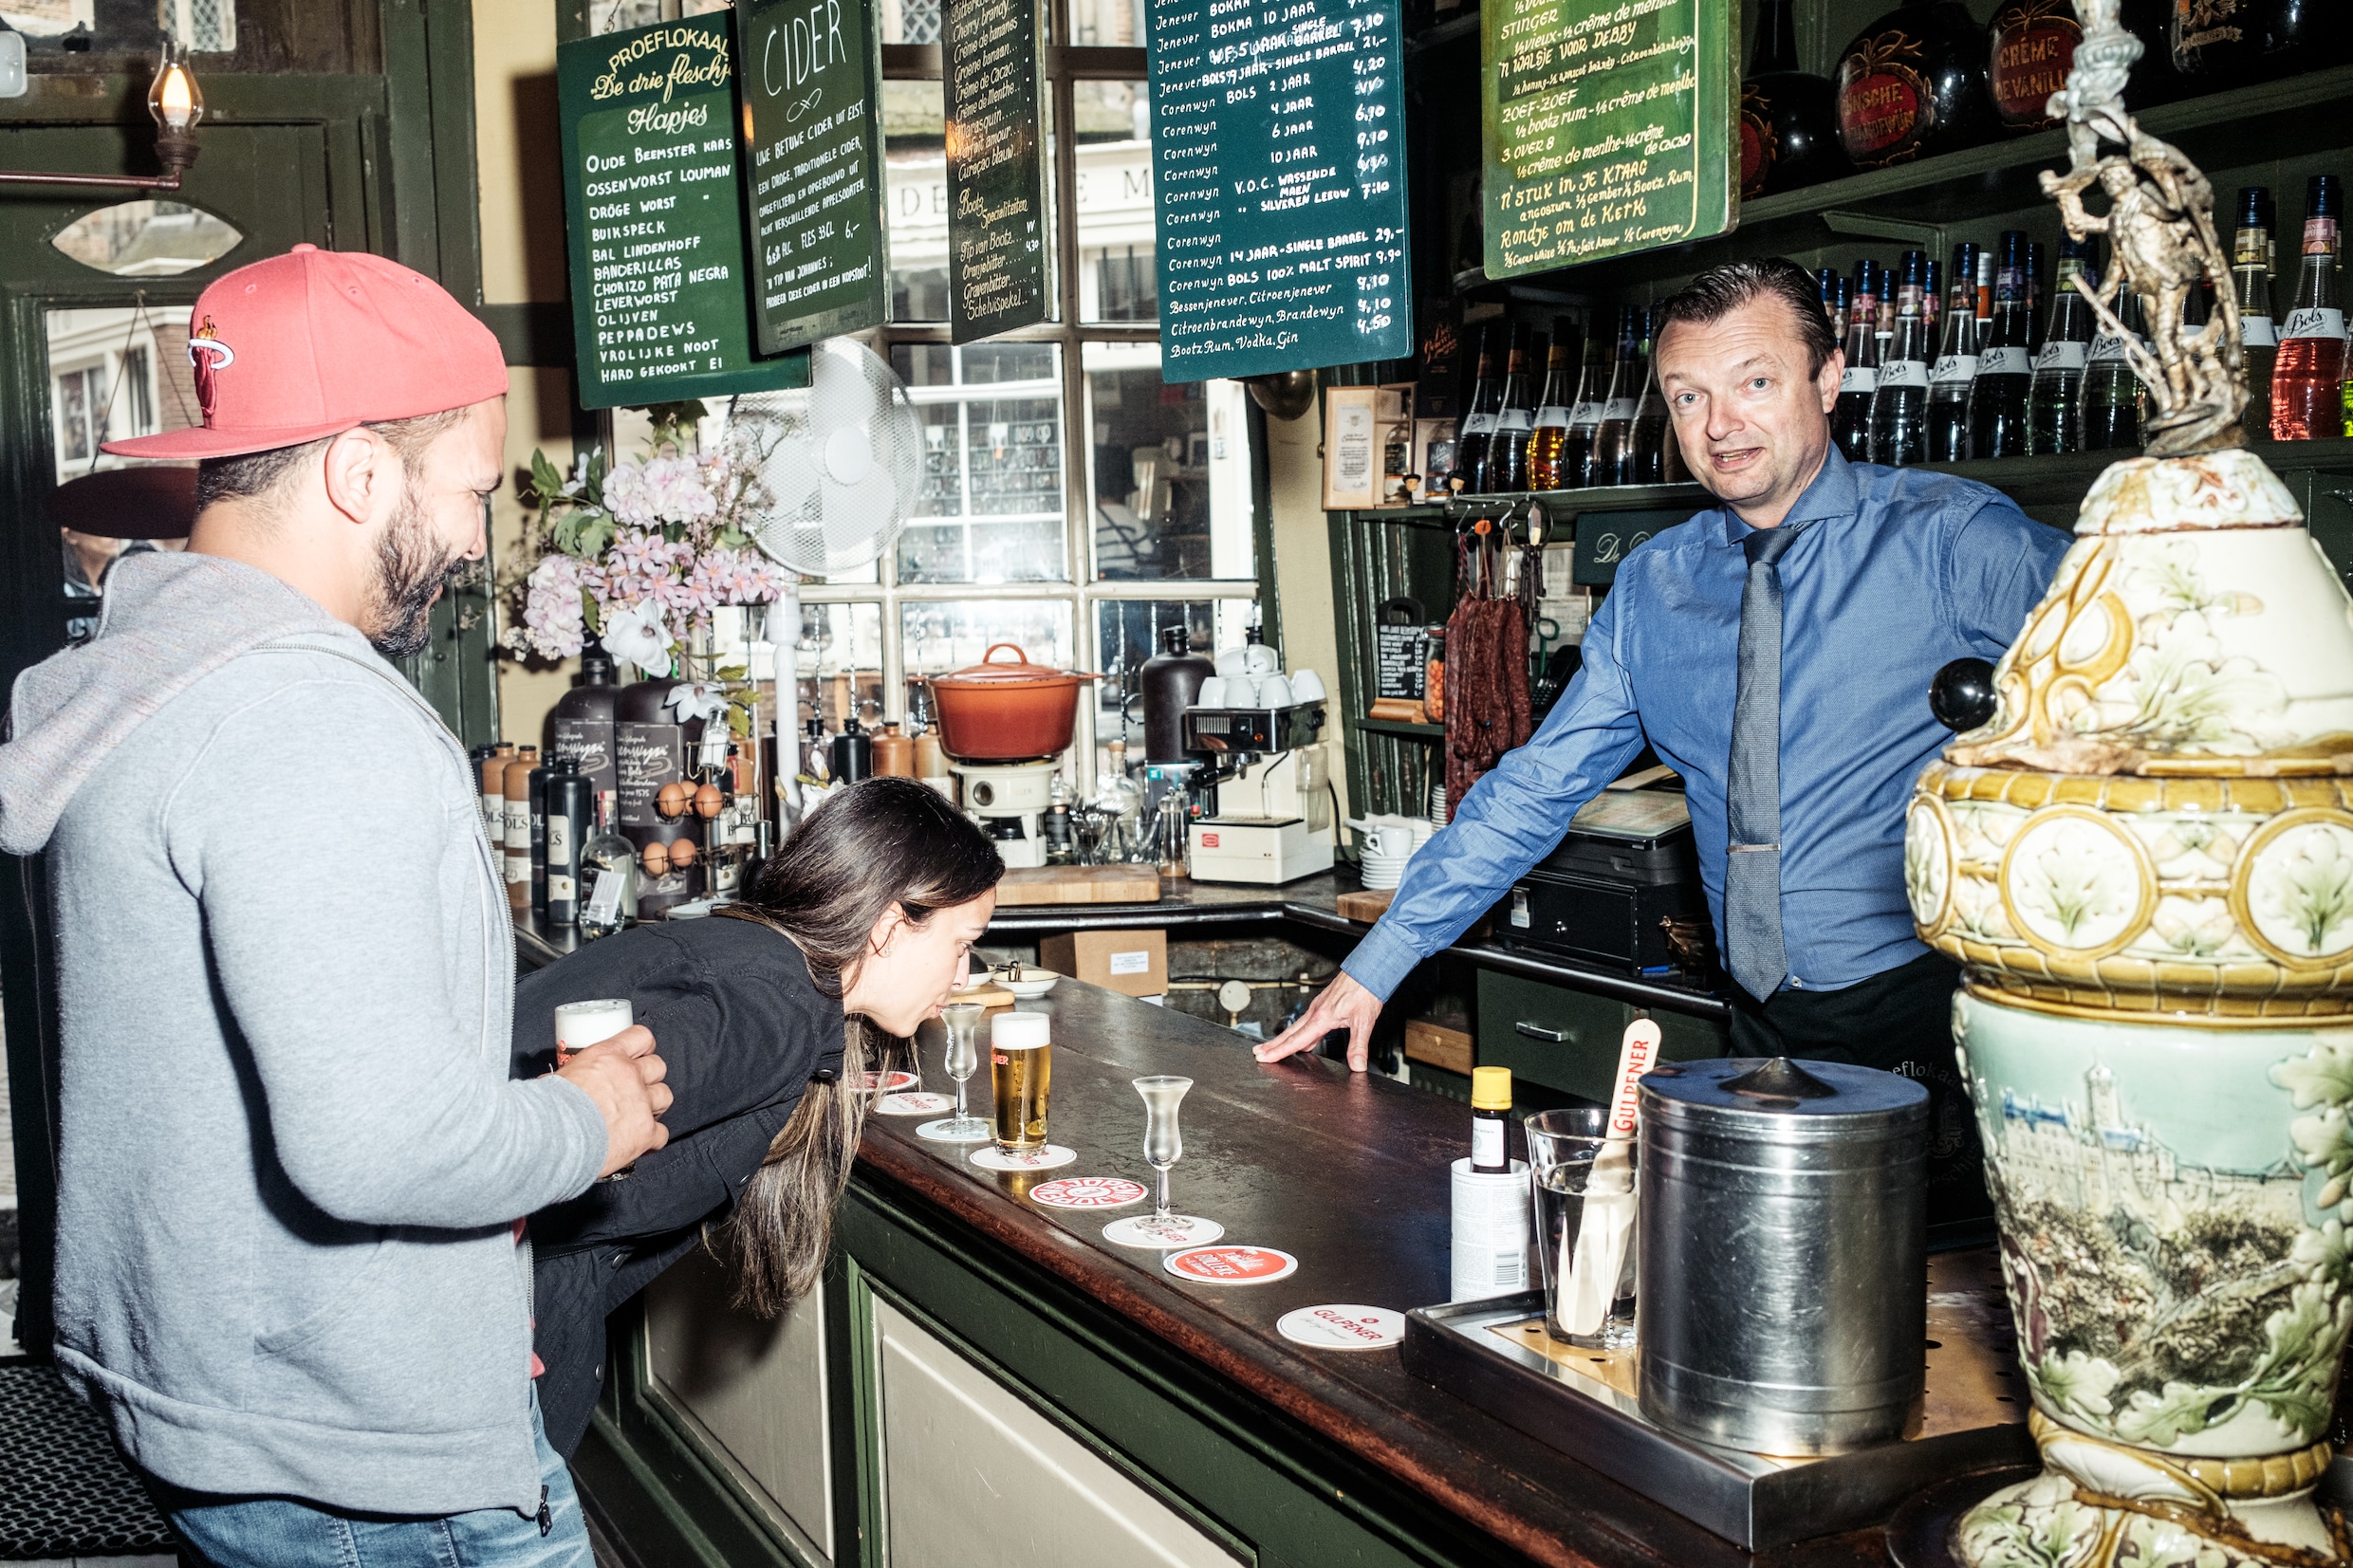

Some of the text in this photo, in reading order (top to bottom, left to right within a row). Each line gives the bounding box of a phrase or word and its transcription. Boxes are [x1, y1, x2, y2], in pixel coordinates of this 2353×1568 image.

[953, 18, 979, 43] Cherry
[978, 30, 988, 48] de
[989, 17, 1018, 43] bananes
[1156, 11, 1199, 30] Jenever
[1157, 1, 1315, 53] Jenever BOKMA 10 JAAR
[1501, 9, 1559, 40] STINGER
[608, 28, 729, 73] PROEFLOKAAL
[764, 0, 846, 96] CIDER
[1158, 56, 1201, 75] Jenever
[1291, 15, 1326, 35] SINGLE
[1560, 38, 1587, 61] VOOR
[1592, 20, 1637, 49] DEBBY
[628, 71, 664, 93] drie
[954, 63, 981, 87] Groene
[980, 73, 989, 89] de
[1158, 78, 1202, 98] Jenever
[1202, 71, 1226, 86] BOLS
[1316, 41, 1355, 60] BARREL
[978, 96, 988, 110] de
[1161, 73, 1311, 116] Corenwyn BOLS 2 JAAR
[627, 101, 708, 135] Hapjes
[807, 117, 833, 140] CIDER
[836, 109, 845, 125] UIT
[1162, 96, 1314, 138] Corenwyn 4 JAAR
[1528, 106, 1587, 136] bootz rum
[1163, 120, 1313, 160] Corenwyn 6 JAAR
[1501, 136, 1555, 163] 3 OVER 8
[1644, 133, 1692, 157] de cacao
[958, 156, 991, 182] Curaçao
[1164, 145, 1318, 182] Corenwyn 10 JAAR
[1565, 147, 1580, 164] de
[586, 164, 731, 196] OSSENWORST LOUMAN
[758, 179, 769, 195] EEN
[793, 148, 837, 178] TRADITIONELE
[759, 159, 860, 217] ONGEFILTERD EN OPGEBOUWD UIT
[1165, 187, 1219, 205] Corenwyn
[1234, 177, 1273, 194] V.O.C.
[1278, 167, 1336, 186] WASSENDE
[1280, 183, 1311, 198] MAEN
[1515, 181, 1553, 207] STUK
[640, 195, 676, 212] WORST
[774, 202, 820, 231] VERSCHILLENDE
[957, 188, 984, 219] Bootz
[981, 197, 1028, 230] Specialiteiten
[1166, 188, 1350, 226] Corenwyn SILVEREN LEEUW
[801, 229, 816, 249] FLES
[1555, 219, 1575, 235] om
[592, 236, 700, 262] BAL LINDENHOFF
[960, 240, 988, 263] Tip van
[1167, 233, 1221, 250] Corenwyn
[1168, 254, 1223, 272] Corenwyn
[1231, 250, 1243, 263] 14
[1327, 231, 1369, 249] BARREL
[593, 266, 729, 297] CHORIZO PATA NEGRA
[594, 257, 682, 281] BANDERILLAS
[774, 256, 827, 286] TIP VAN JOHANNES
[1169, 253, 1371, 293] Corenwyn BOLS 100% MALT SPIRIT
[595, 290, 677, 313] LEVERWORST
[766, 294, 787, 309] PROBEER
[787, 288, 803, 302] DEZE
[804, 282, 821, 297] CIDER
[828, 274, 841, 288] EEN
[1250, 284, 1332, 304] Citroenjenever
[598, 309, 658, 327] OLIJVEN
[1276, 304, 1343, 323] Brandewyn
[2286, 307, 2323, 337] Bols
[599, 322, 695, 345] PEPPADEWS
[1275, 331, 1299, 350] Gin
[2089, 334, 2121, 359] Bols
[600, 339, 718, 362] VROLIJKE NOOT
[1981, 348, 2004, 370] Bols
[602, 358, 722, 383] HARD GEKOOKT EI
[1884, 361, 1908, 381] Bols
[1936, 356, 1957, 378] Bols
[1593, 532, 1621, 563] De
[1613, 1039, 1650, 1134] GULPENER
[1314, 1309, 1383, 1340] GULPENER
